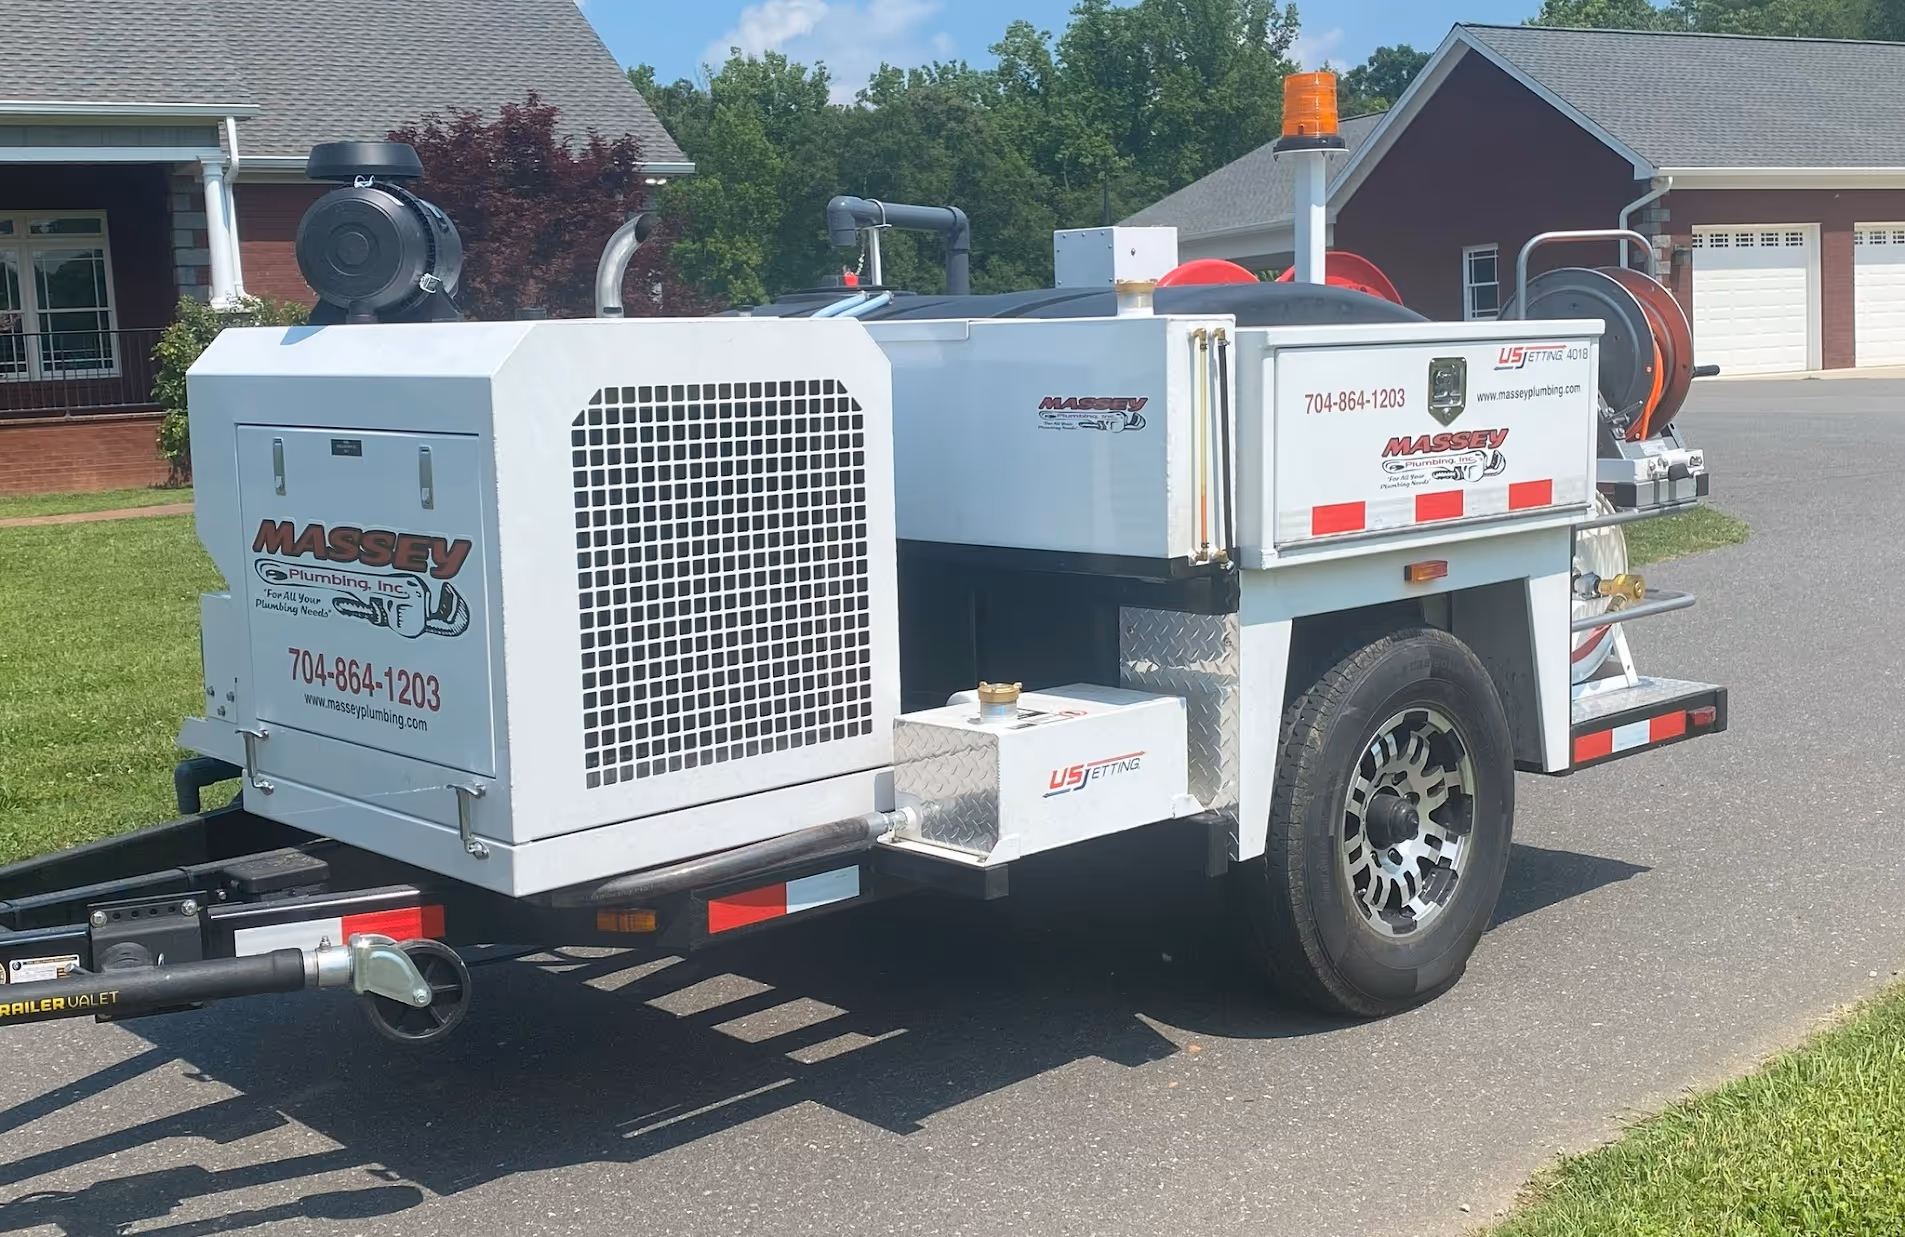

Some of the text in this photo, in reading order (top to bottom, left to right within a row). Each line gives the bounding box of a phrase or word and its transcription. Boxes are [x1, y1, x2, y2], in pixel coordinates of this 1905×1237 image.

[1566, 348, 1589, 361] 4018
[1038, 396, 1149, 412] MASSEY
[1304, 387, 1405, 414] 704-864-1203
[1476, 384, 1581, 402] www.masseyplumbing.com
[1381, 428, 1509, 458] MASSEY
[252, 519, 473, 580] MASSEY
[283, 591, 297, 602] All
[298, 593, 321, 605] Your
[378, 579, 408, 595] Inc.
[255, 598, 298, 616] Plumbing
[288, 647, 441, 712] 704-864-1203
[304, 692, 428, 732] www.masseyplumbing.com
[0, 990, 119, 1017] RAILER VALET
